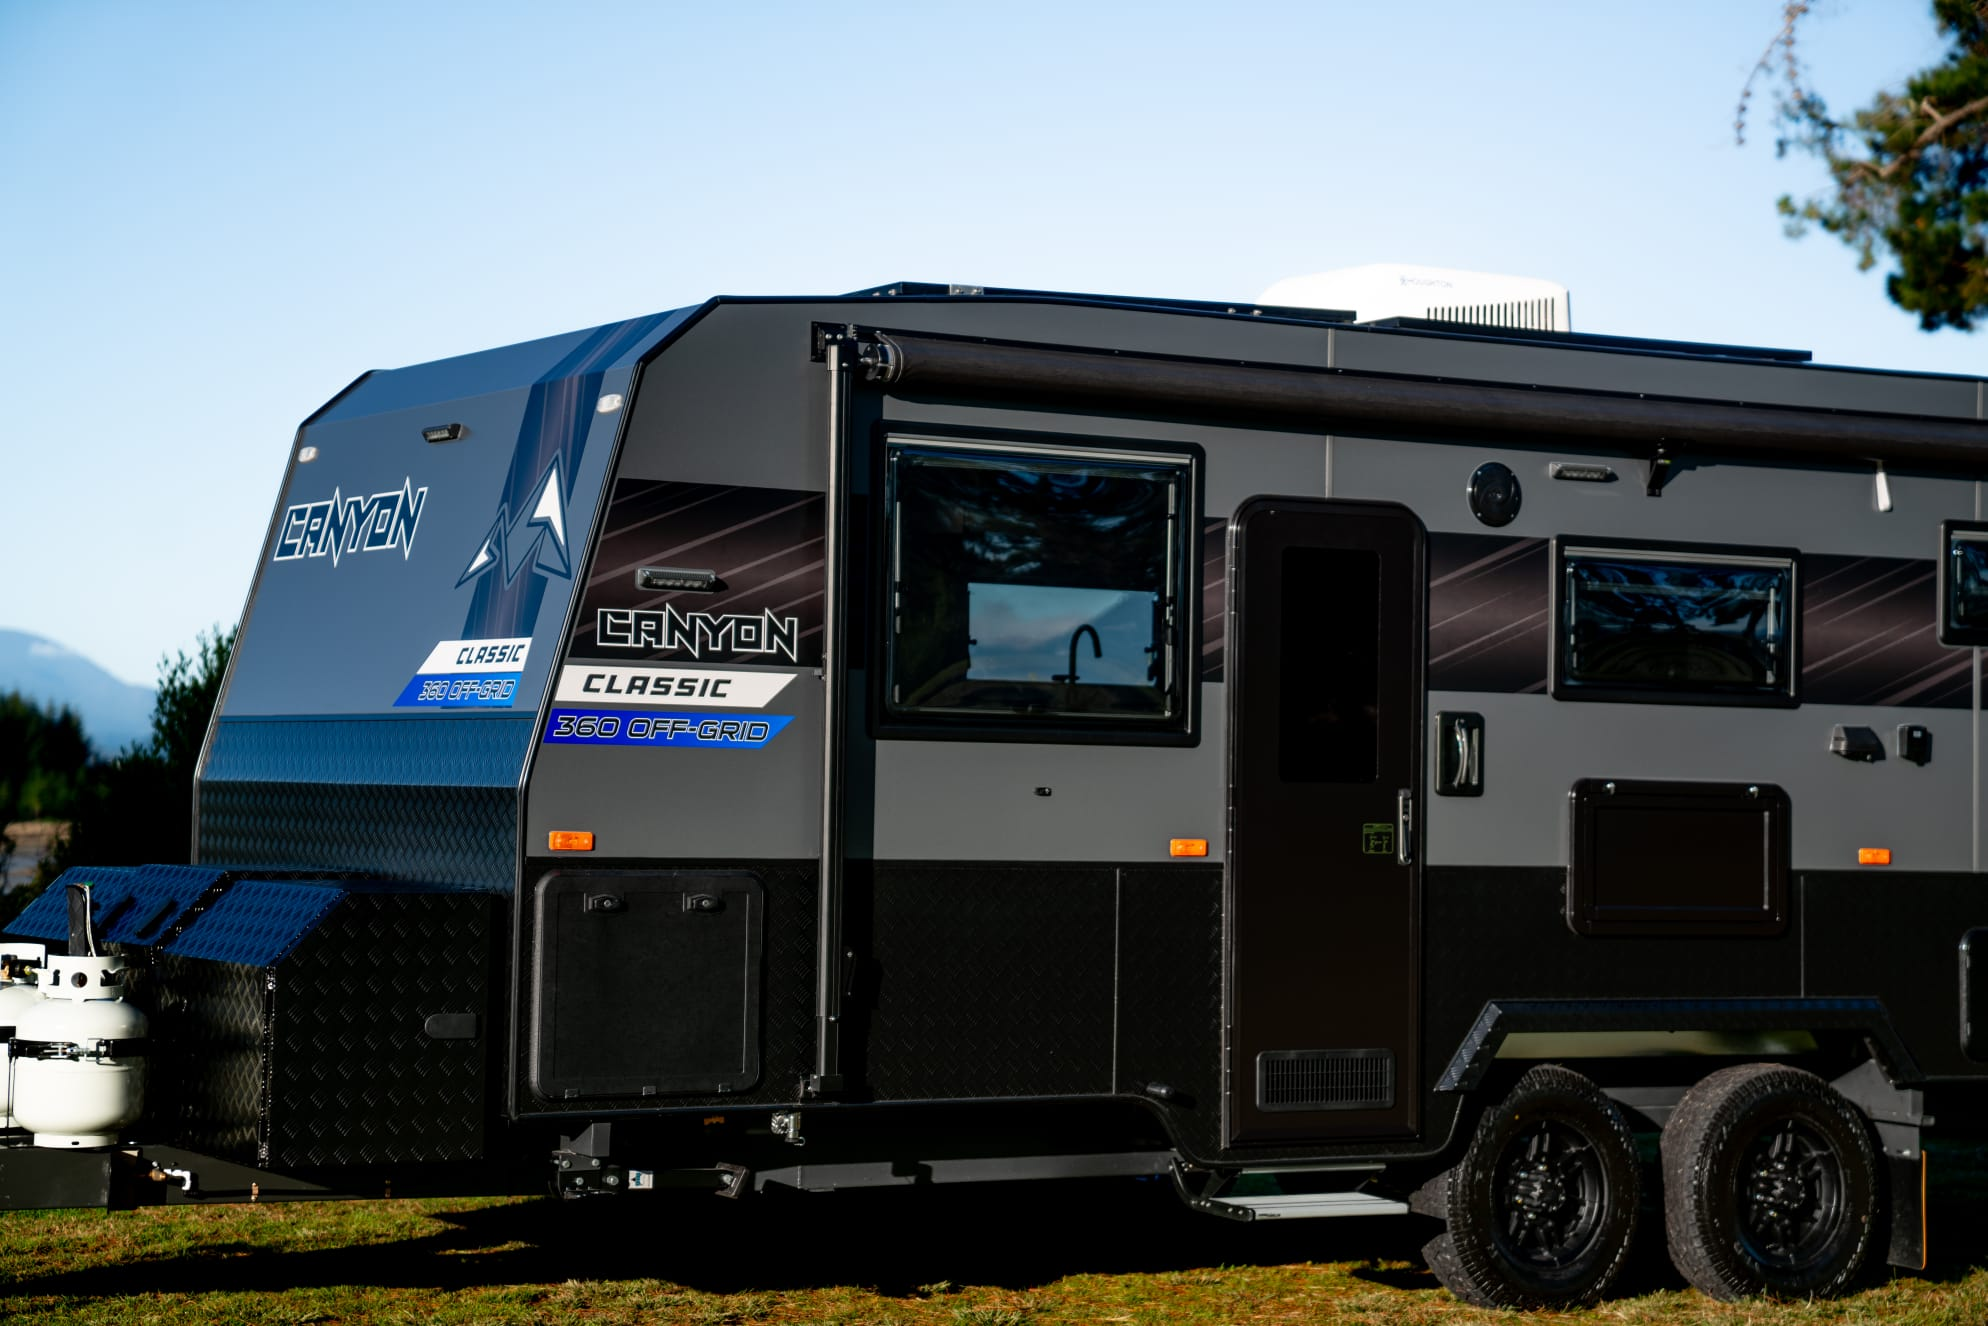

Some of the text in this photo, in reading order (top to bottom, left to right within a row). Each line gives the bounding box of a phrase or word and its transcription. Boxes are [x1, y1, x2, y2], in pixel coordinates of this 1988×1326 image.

[273, 476, 429, 568] CANYON
[597, 602, 799, 663] CANYON
[456, 644, 526, 665] CLASSIC
[417, 679, 517, 701] 360 OFF-GRID
[582, 673, 732, 698] CLASSIC
[553, 715, 770, 743] 360 OFF-GRID
